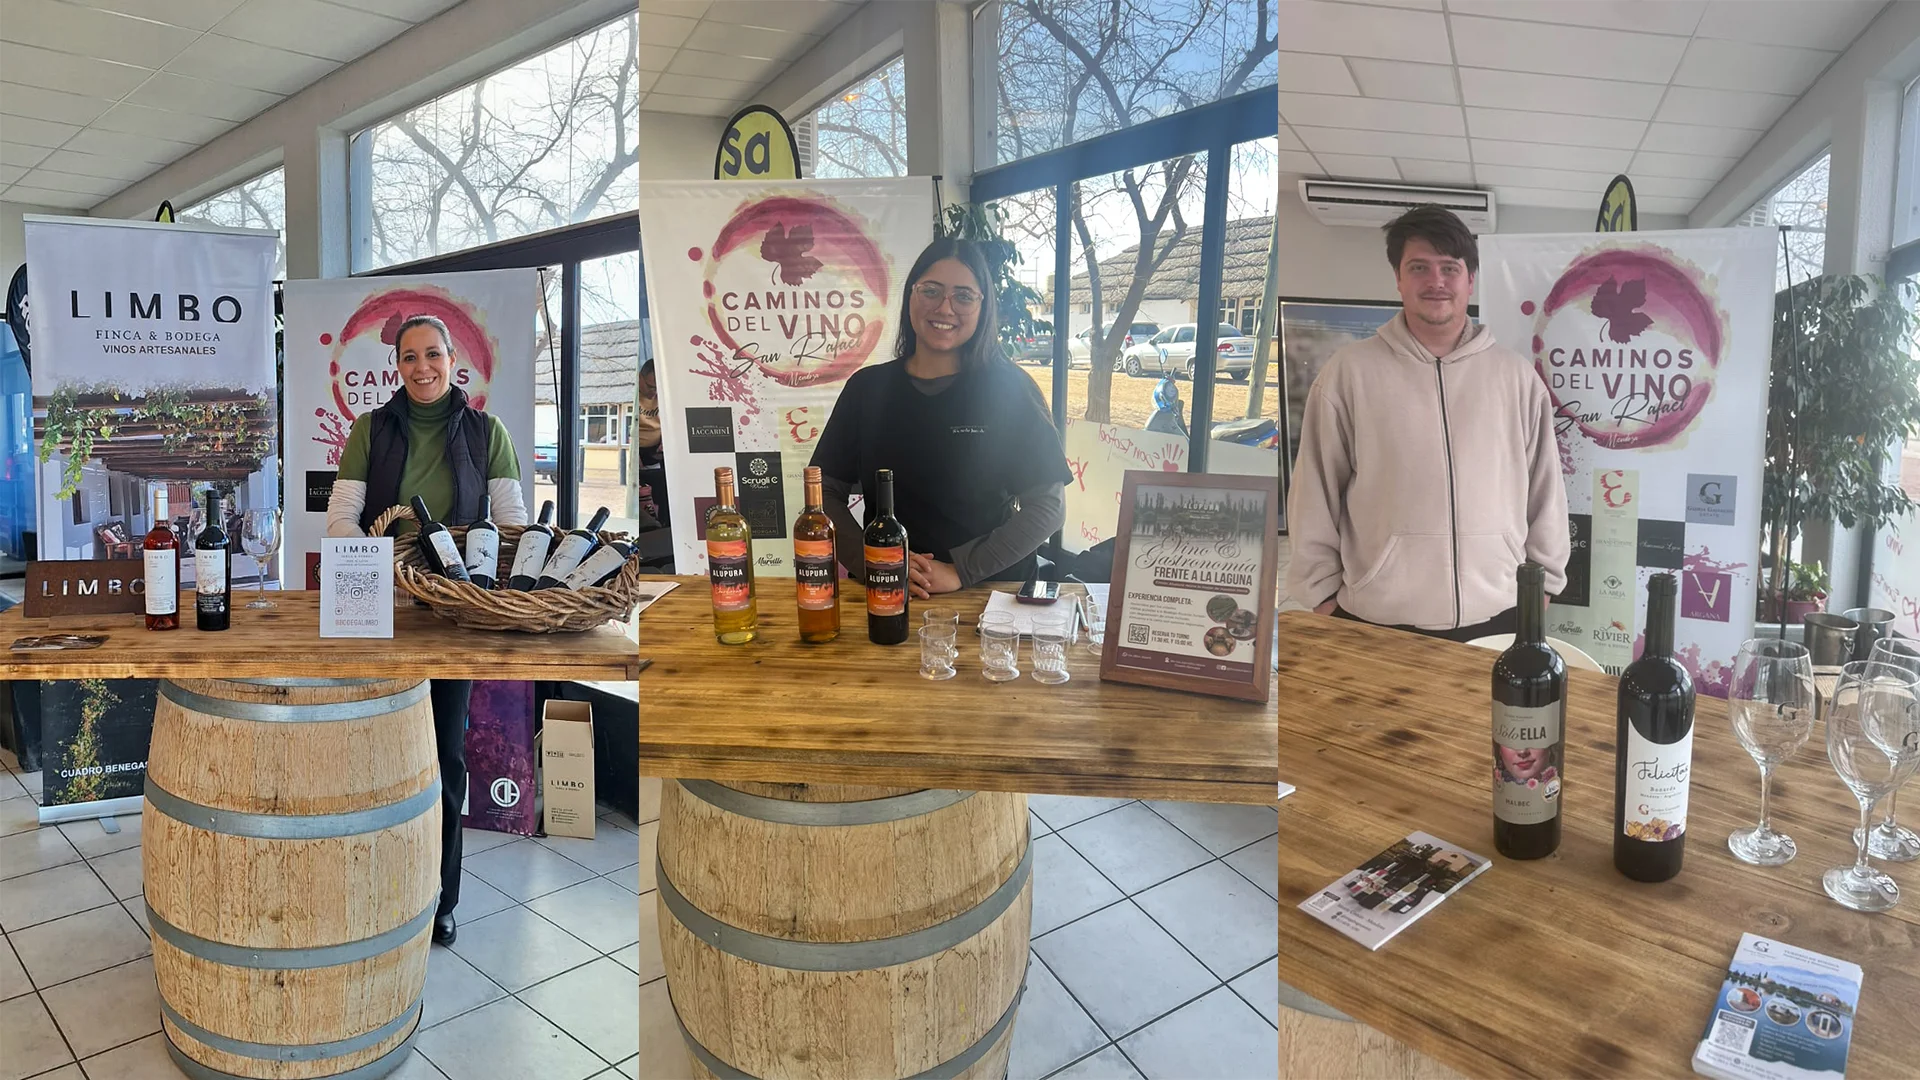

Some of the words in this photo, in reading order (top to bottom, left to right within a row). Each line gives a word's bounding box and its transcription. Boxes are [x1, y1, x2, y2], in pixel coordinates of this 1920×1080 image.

[722, 127, 771, 176] sa
[71, 290, 243, 324] LIMBO
[722, 289, 865, 311] CAMINOS
[727, 315, 771, 332] DEL
[777, 312, 866, 340] VINO
[95, 329, 142, 341] FINCA
[148, 331, 158, 341] &
[165, 331, 221, 342] BODEGA
[102, 344, 137, 354] VINOS
[138, 345, 217, 355] ARTESANALES
[730, 342, 781, 379] San
[1549, 347, 1694, 370] CAMINOS
[344, 367, 470, 387] CAMS
[1552, 373, 1595, 390] DEL
[1601, 372, 1693, 401] VINO
[347, 391, 384, 405] DEL
[1554, 400, 1602, 436] San
[691, 426, 730, 435] IACCARINI
[741, 476, 770, 485] Scrugli
[335, 545, 379, 553] LIMBO
[712, 569, 743, 578] ALUPURA
[799, 568, 828, 578] ALUPURA
[869, 574, 899, 583] ALUPURA
[1153, 566, 1190, 581] FRENTE
[1191, 569, 1198, 581] A
[1200, 570, 1212, 582] LA
[1214, 572, 1253, 586] LAGUNA
[42, 578, 145, 597] LIMBO
[1128, 591, 1162, 603] EXPERIENCIA
[1162, 594, 1194, 606] COMPLETA:
[1689, 611, 1720, 620] ARGANA
[1593, 629, 1631, 644] RIVIER
[1520, 726, 1547, 740] ELLA
[61, 766, 103, 778] CUADRO
[550, 779, 585, 789] LIMBO
[1505, 798, 1531, 807] MALBEC
